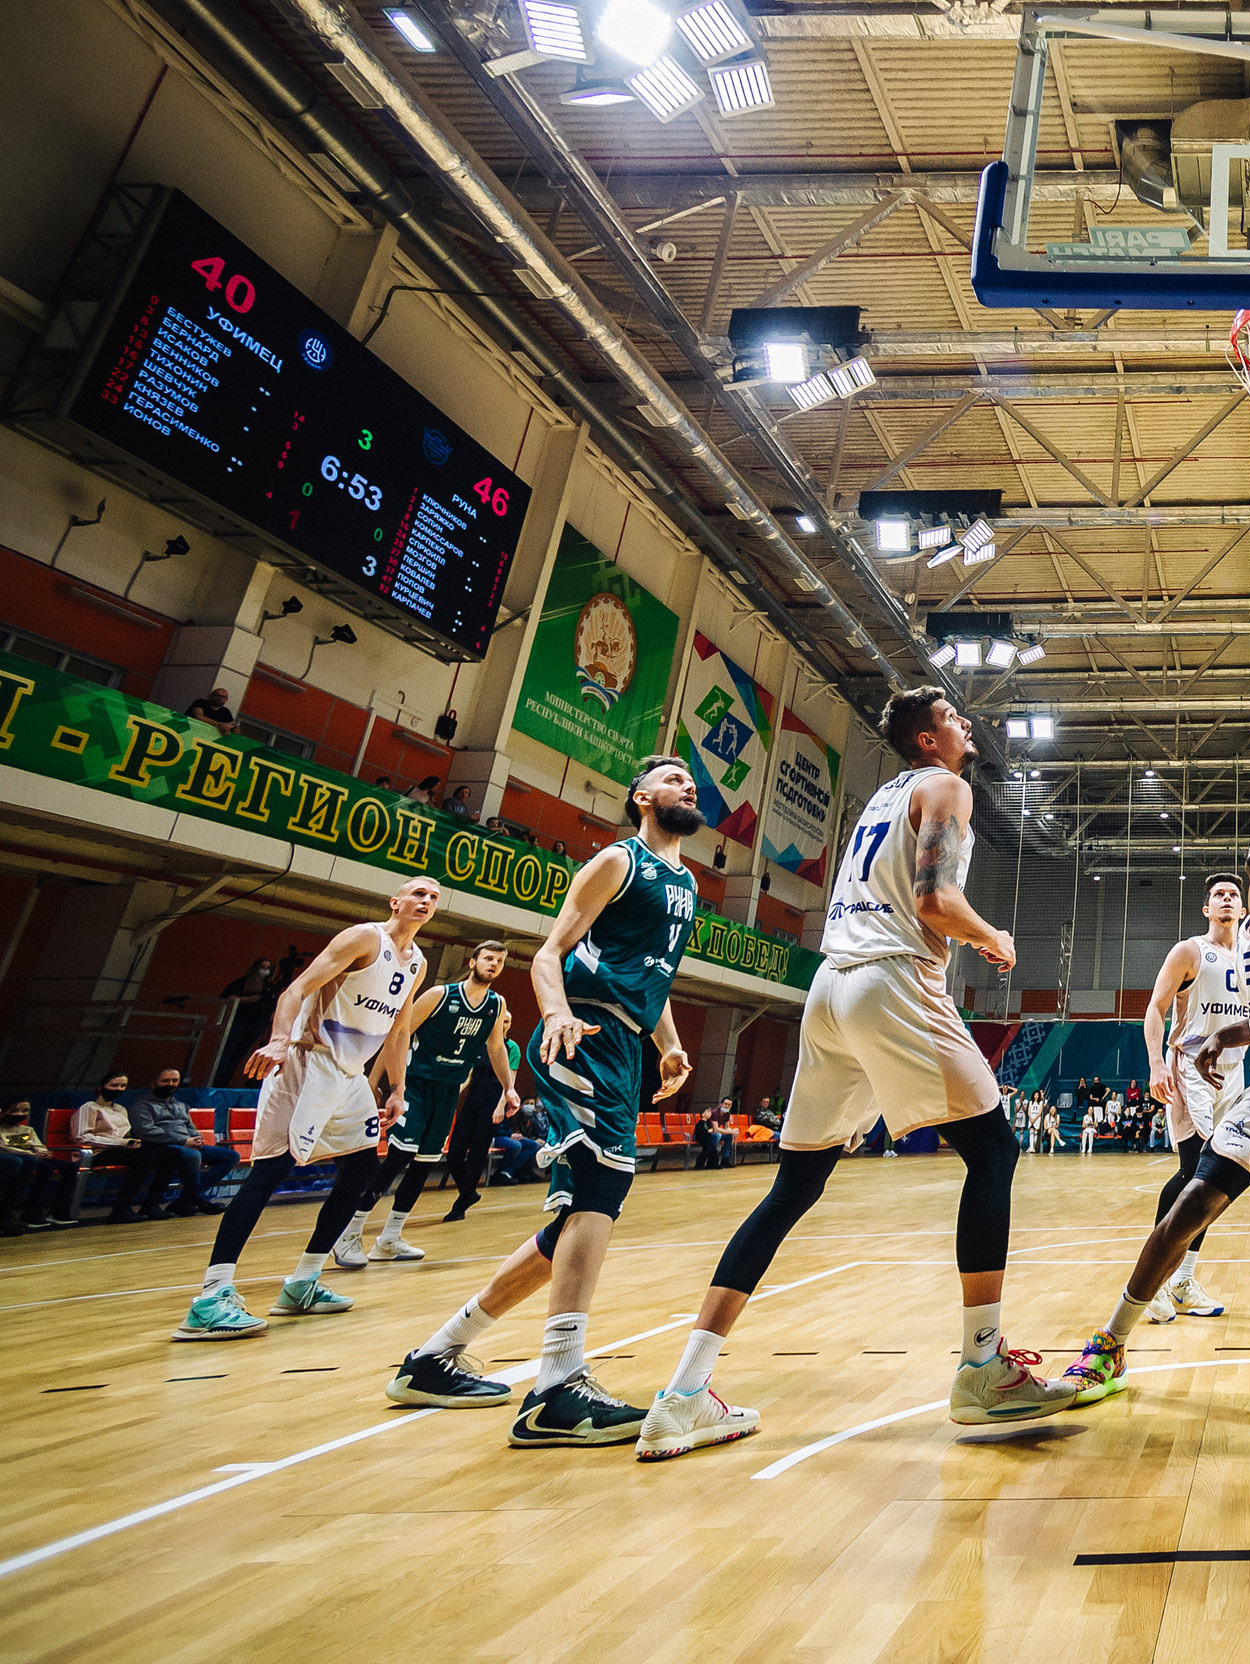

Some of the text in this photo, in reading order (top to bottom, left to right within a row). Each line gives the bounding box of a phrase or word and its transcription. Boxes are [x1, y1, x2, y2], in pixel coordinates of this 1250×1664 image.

[190, 256, 256, 314] 40
[162, 316, 219, 363] БЕРНАРД
[167, 306, 232, 357] БЕСТУЖЕВ
[206, 305, 283, 373] УФИМЕЦ
[152, 337, 220, 387] ВЕННИКОВ
[157, 327, 208, 367] ИСАКОВ
[143, 358, 198, 399] ШЕВЧУК
[149, 347, 208, 393] ТИХОНИН
[133, 380, 184, 417] КНЯЗЕВ
[138, 369, 199, 413] РАЗУМОВ
[123, 402, 172, 436] ИОНОВ
[128, 391, 220, 453] ГЕРАСИМЕНКО
[358, 429, 373, 450] 3
[302, 482, 313, 497] 0
[321, 455, 383, 511] 6:53
[473, 477, 510, 517] 46
[419, 502, 455, 531] ЗАРЯЖКО
[422, 493, 468, 531] КЛЮЧНИКОВ
[452, 493, 477, 520] РУНА
[374, 528, 383, 541] 0
[417, 511, 443, 534] СОПИН
[411, 528, 446, 555] КАРПЕКО
[414, 519, 464, 558] КОМИССАРОВ
[362, 555, 377, 577] 3
[402, 554, 436, 580] ПЕРШИН
[405, 545, 437, 571] МОЗГОВ
[397, 572, 425, 594] ПОПОВ
[400, 563, 436, 591] КОВАЛЕВ
[391, 590, 432, 619] КАРПАЧЕВ
[394, 581, 435, 611] КУРЦЕВИЧ
[795, 752, 821, 780] ЦЕНТР
[108, 714, 436, 869] РЕГИОН
[445, 831, 571, 909] СПОР
[706, 922, 789, 984] ПОБЕД!
[389, 971, 405, 995] 8
[1201, 1003, 1249, 1018] УФИМЕ
[453, 1038, 466, 1055] 3
[365, 1115, 379, 1137] 8
